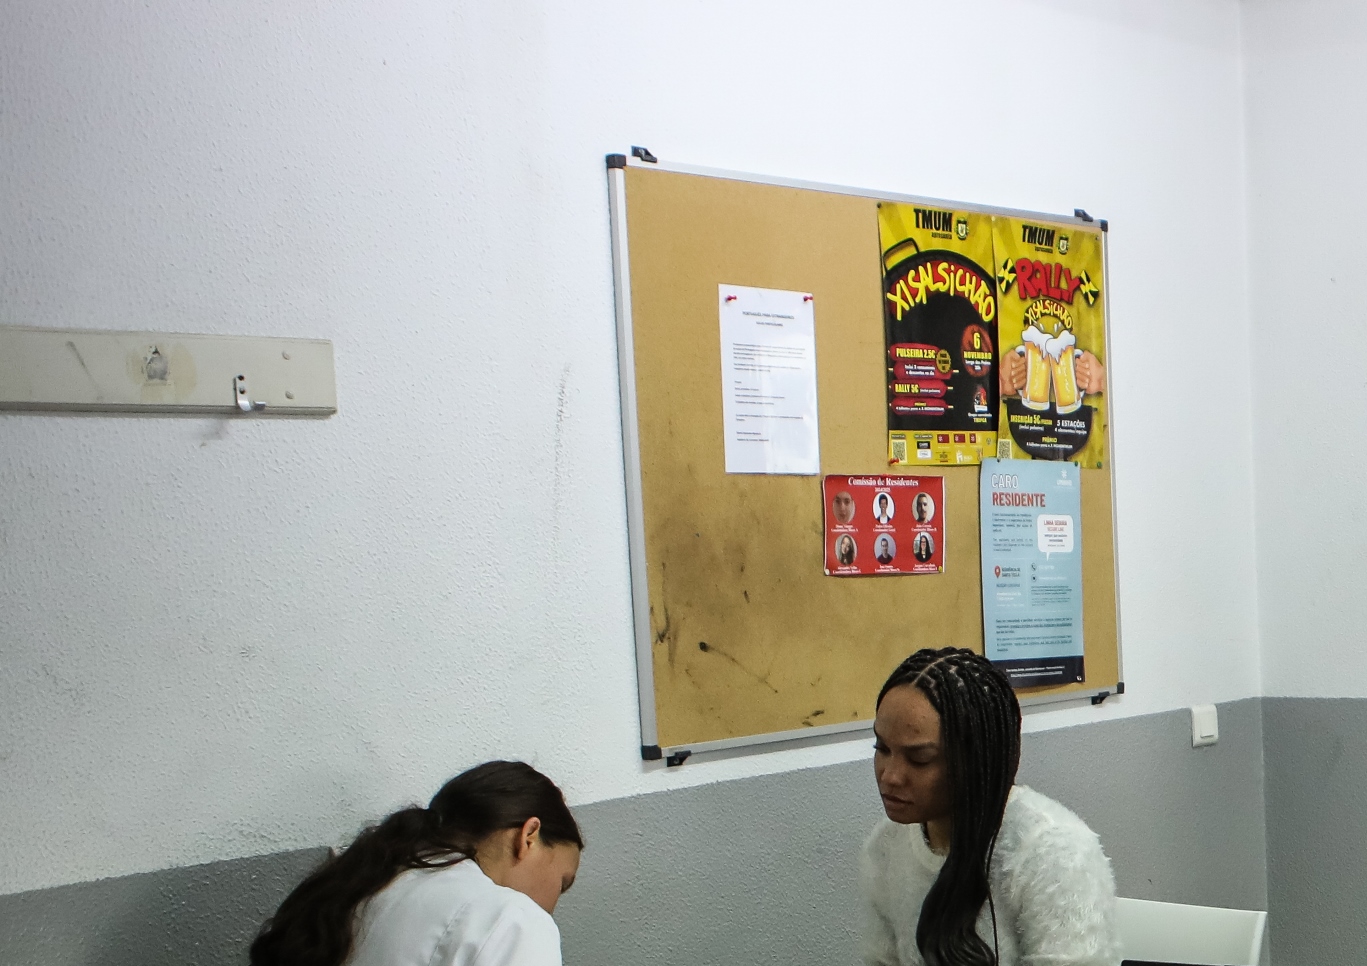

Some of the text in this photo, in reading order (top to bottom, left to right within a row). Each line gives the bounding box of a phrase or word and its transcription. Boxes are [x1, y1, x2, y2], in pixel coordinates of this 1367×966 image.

[913, 208, 953, 232] TMUM
[1022, 224, 1056, 248] TMUM
[1015, 257, 1081, 305] RALLY
[973, 332, 981, 350] 6
[896, 347, 923, 359] PULSEIRA
[894, 383, 910, 393] RALLY
[848, 477, 919, 487] Comissão de Residentes
[991, 474, 1019, 489] CARO
[992, 491, 1046, 508] RESIDENTE
